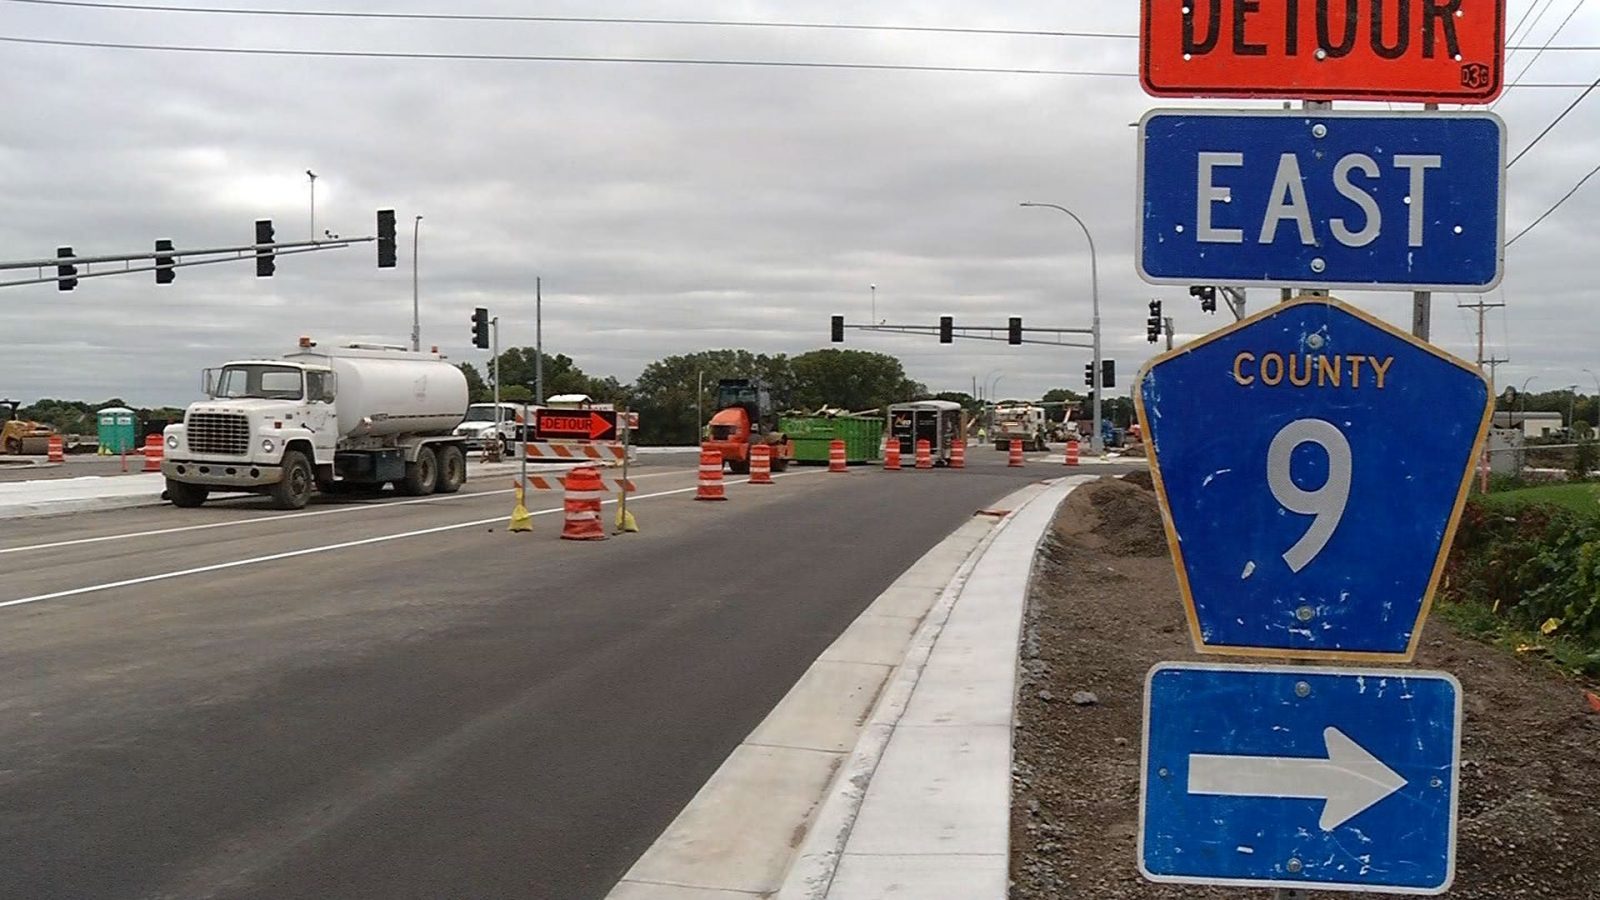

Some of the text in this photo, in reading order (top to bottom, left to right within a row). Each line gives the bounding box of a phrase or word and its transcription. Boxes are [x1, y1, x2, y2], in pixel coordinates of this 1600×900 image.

[1196, 152, 1441, 247] EAST
[1233, 352, 1394, 388] COUNTY
[545, 418, 593, 430] DETOUR
[1267, 418, 1352, 573] 9
